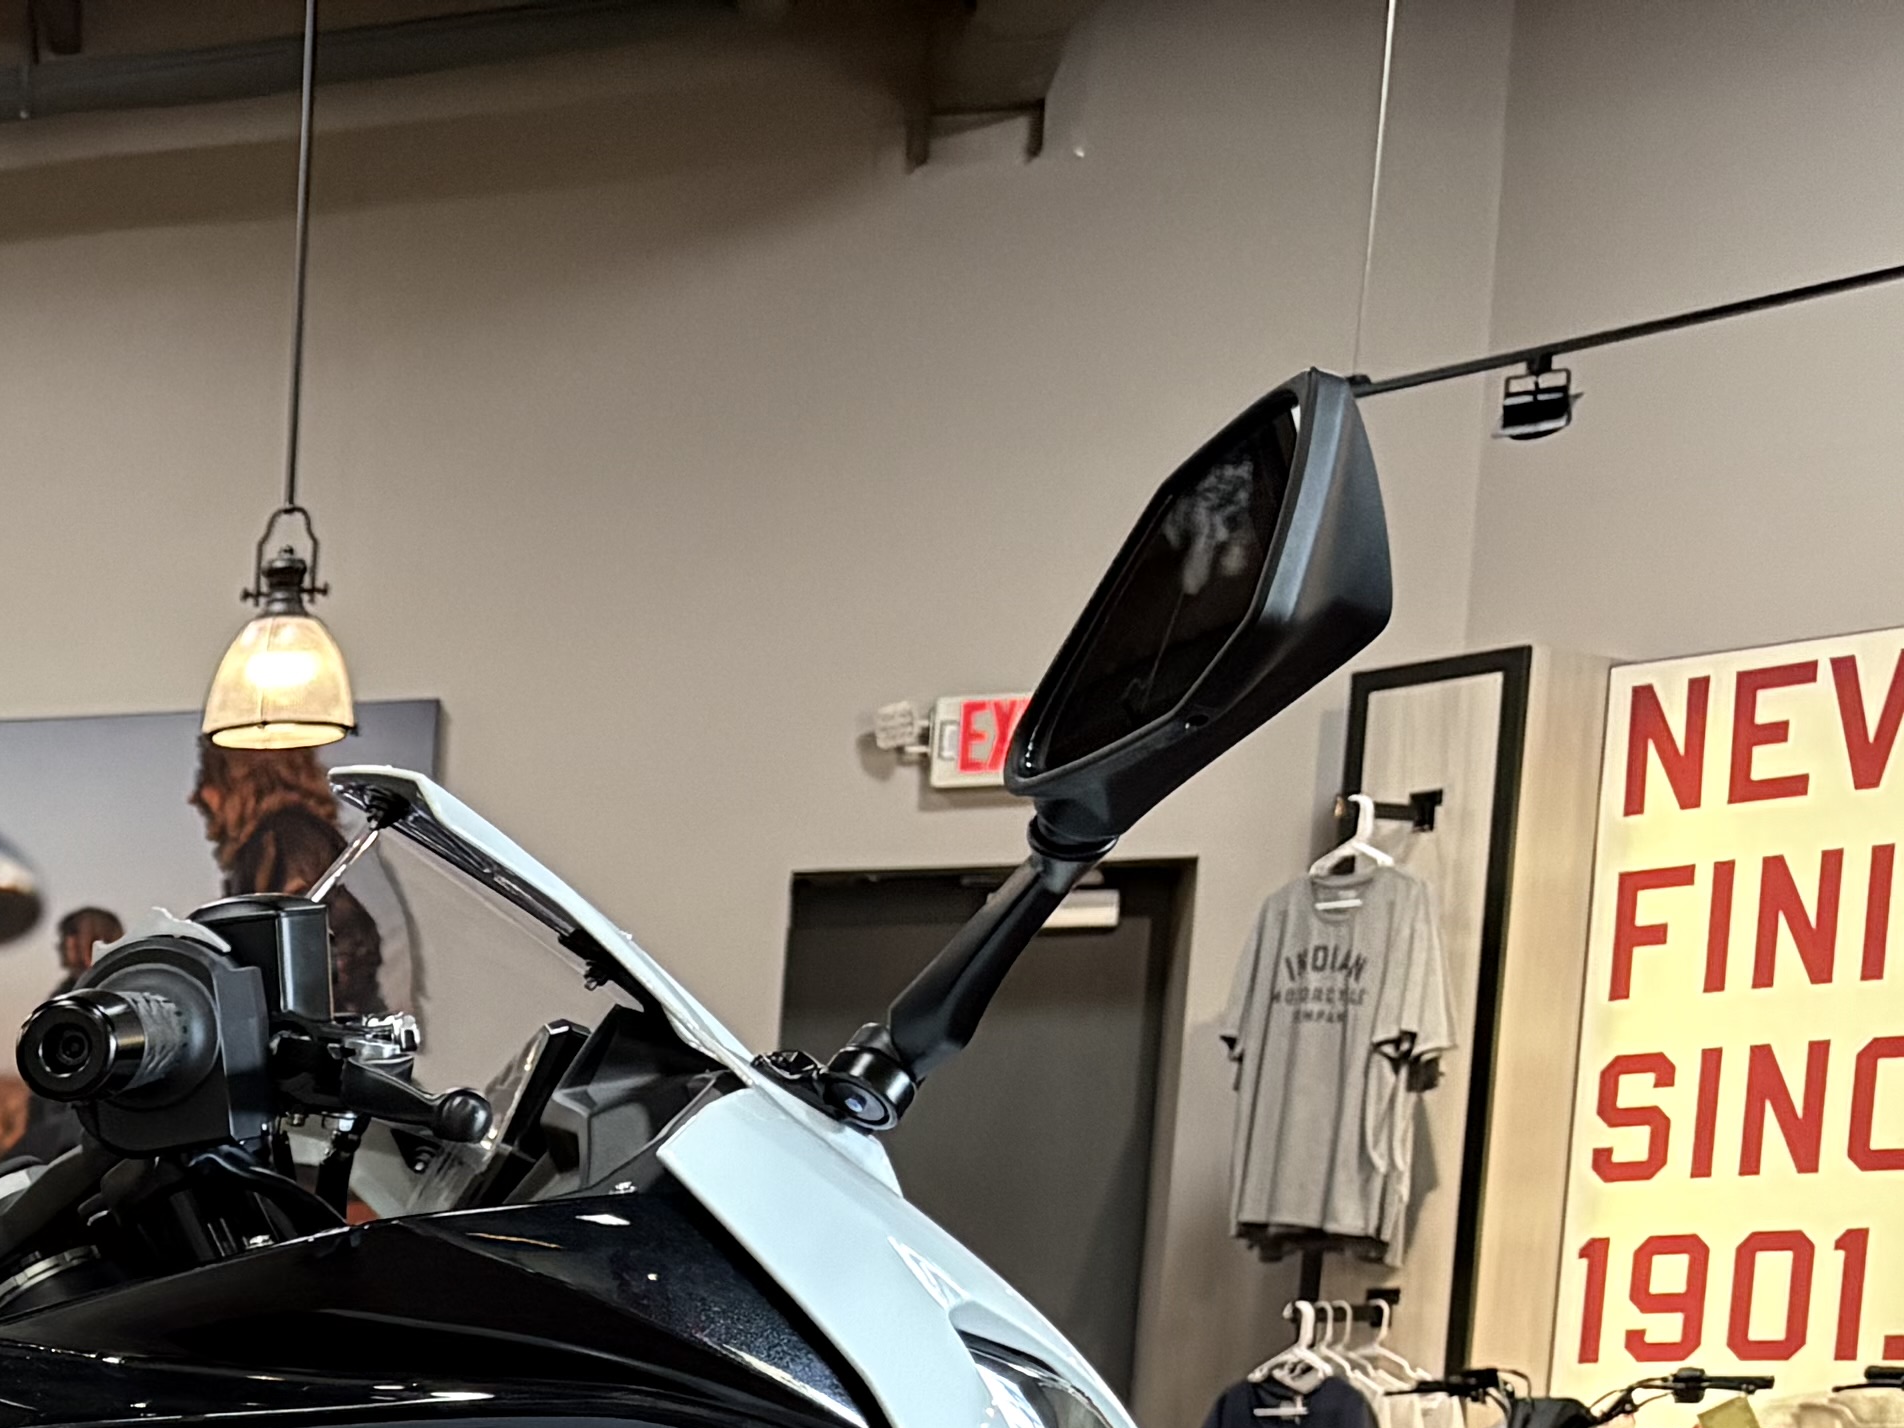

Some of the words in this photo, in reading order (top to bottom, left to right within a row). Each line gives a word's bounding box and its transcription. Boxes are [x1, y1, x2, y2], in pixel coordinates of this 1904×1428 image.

[958, 698, 1030, 773] EX
[1608, 840, 1904, 1003] FINI
[1284, 944, 1367, 982] INDIAN
